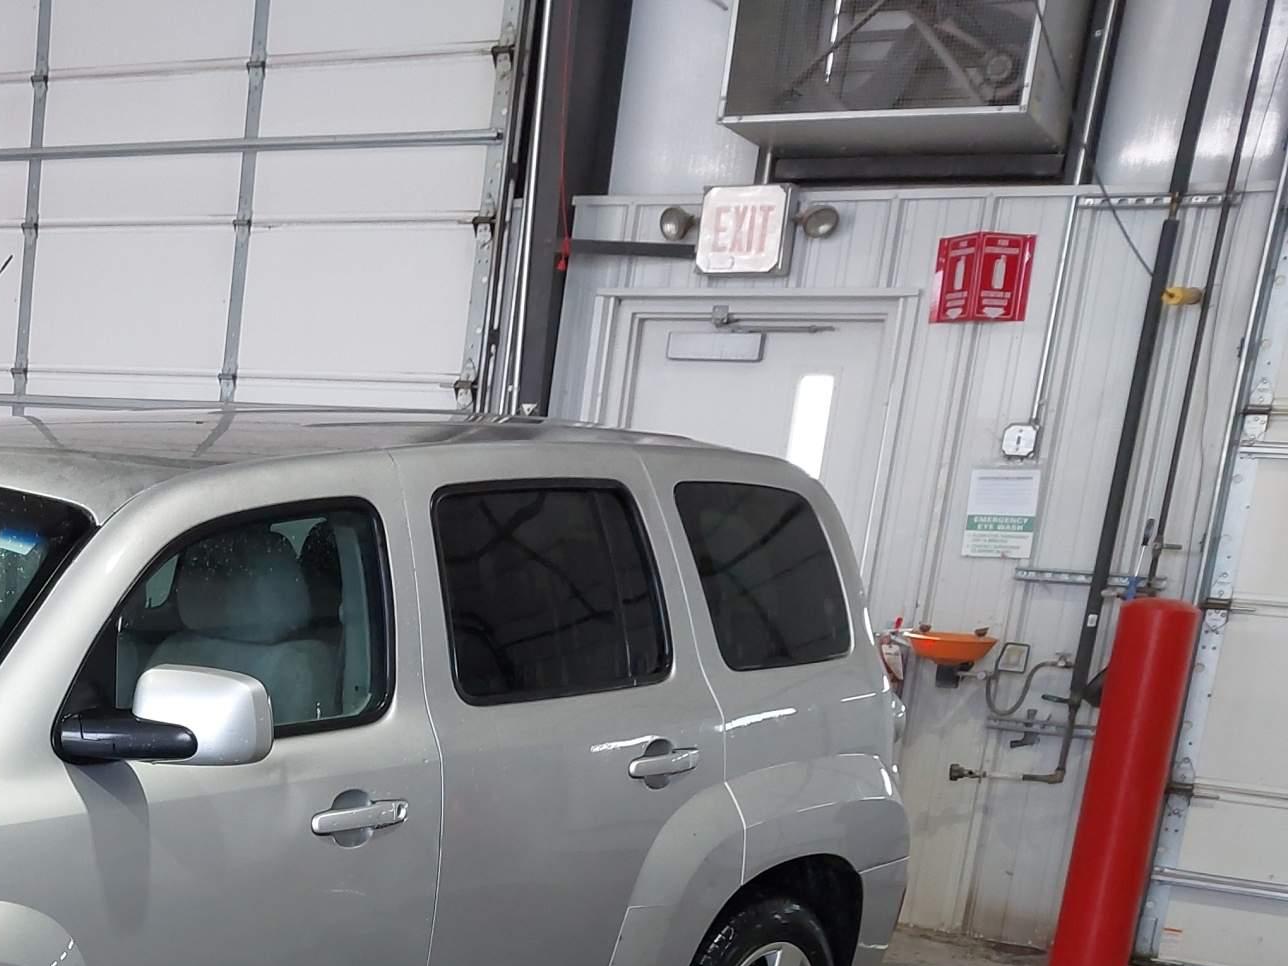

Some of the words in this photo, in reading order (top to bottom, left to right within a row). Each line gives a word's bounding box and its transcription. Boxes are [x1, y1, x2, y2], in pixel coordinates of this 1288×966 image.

[712, 204, 776, 254] EXIT
[973, 516, 1029, 525] EMERGENCY
[977, 523, 994, 531] EYE
[997, 523, 1024, 532] WASH
